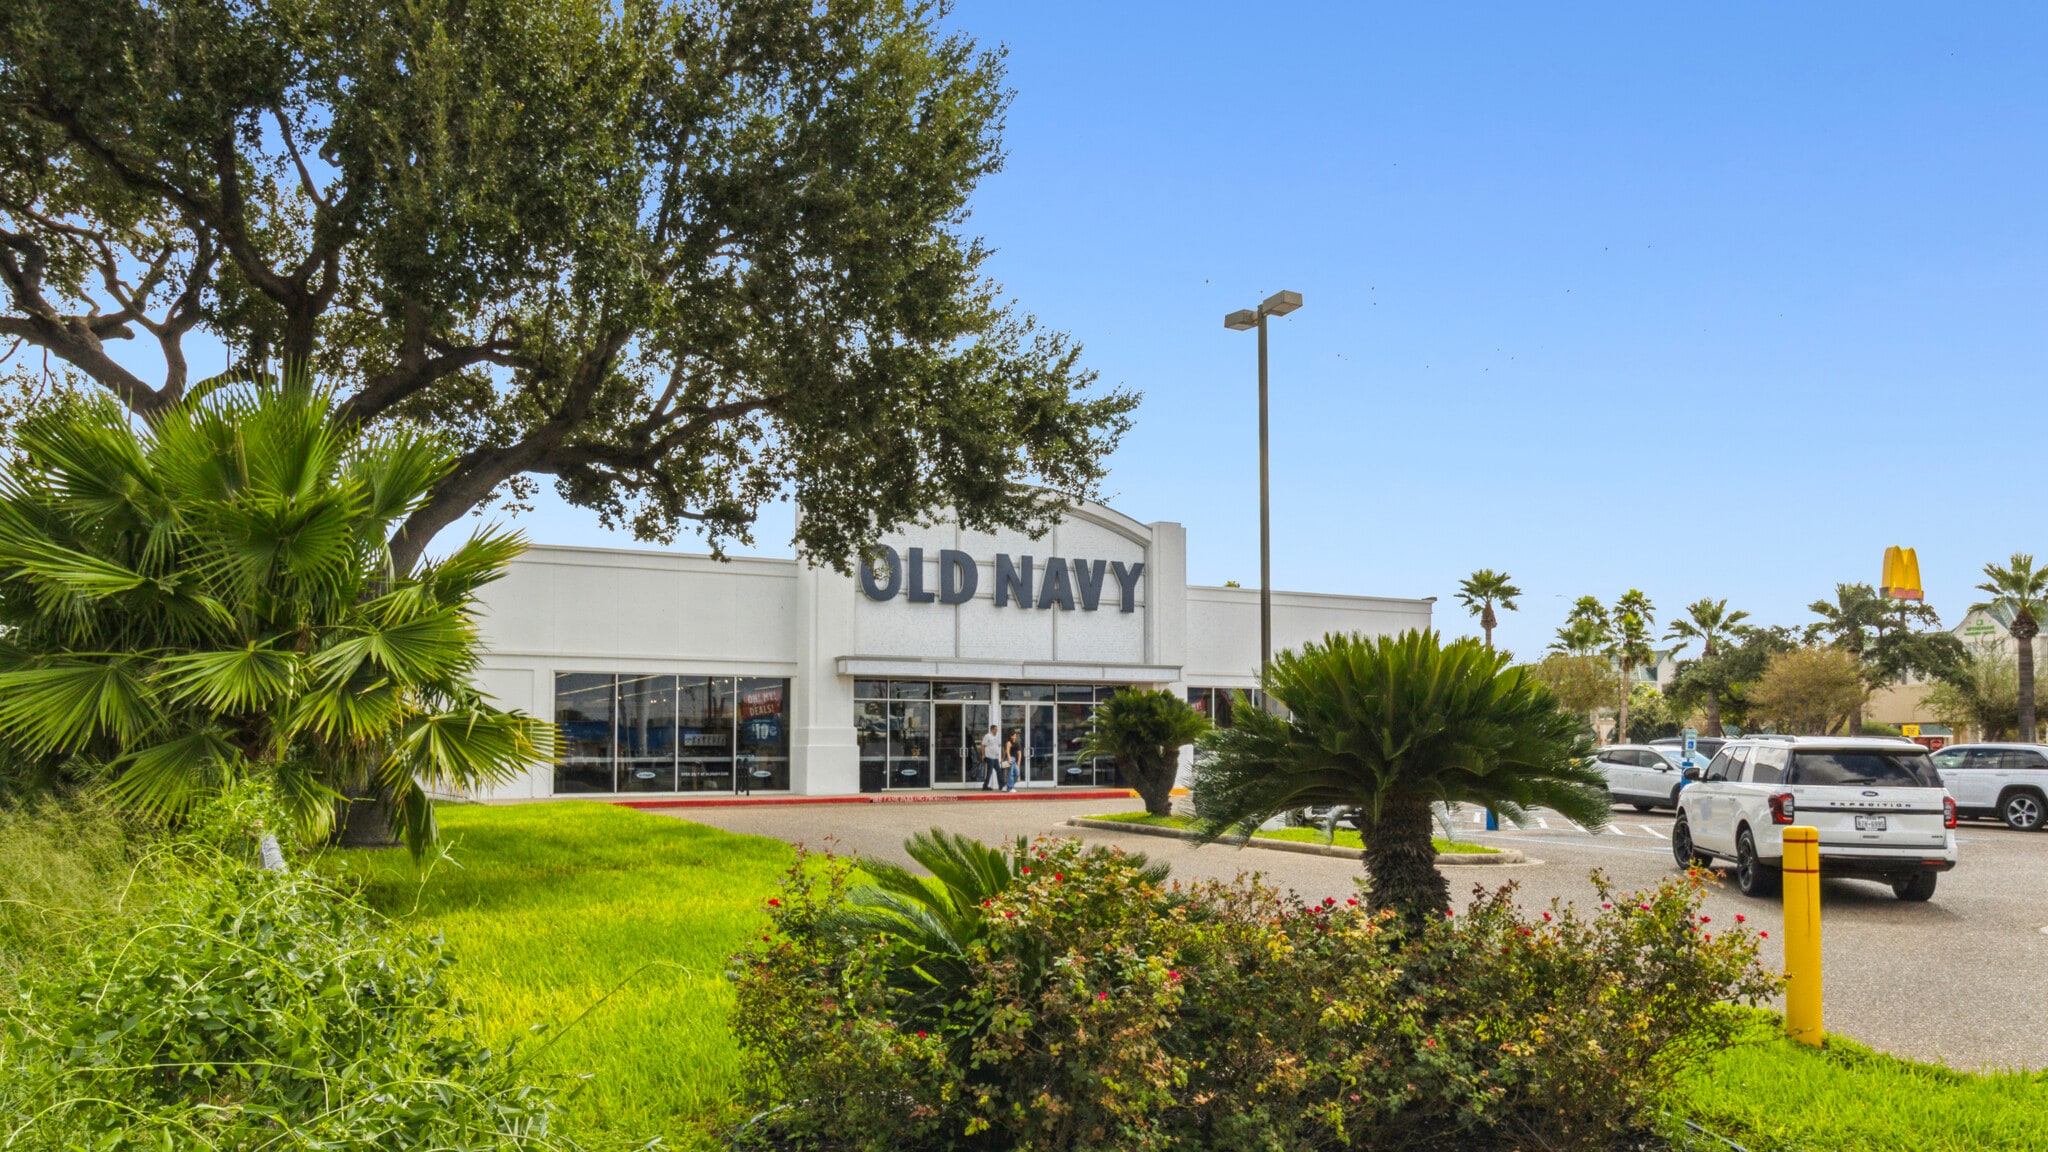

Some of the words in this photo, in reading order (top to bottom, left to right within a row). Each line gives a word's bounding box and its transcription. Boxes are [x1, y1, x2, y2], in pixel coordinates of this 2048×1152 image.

[858, 544, 978, 604] OLD
[994, 553, 1145, 613] NAVY
[749, 704, 775, 716] DEALS!
